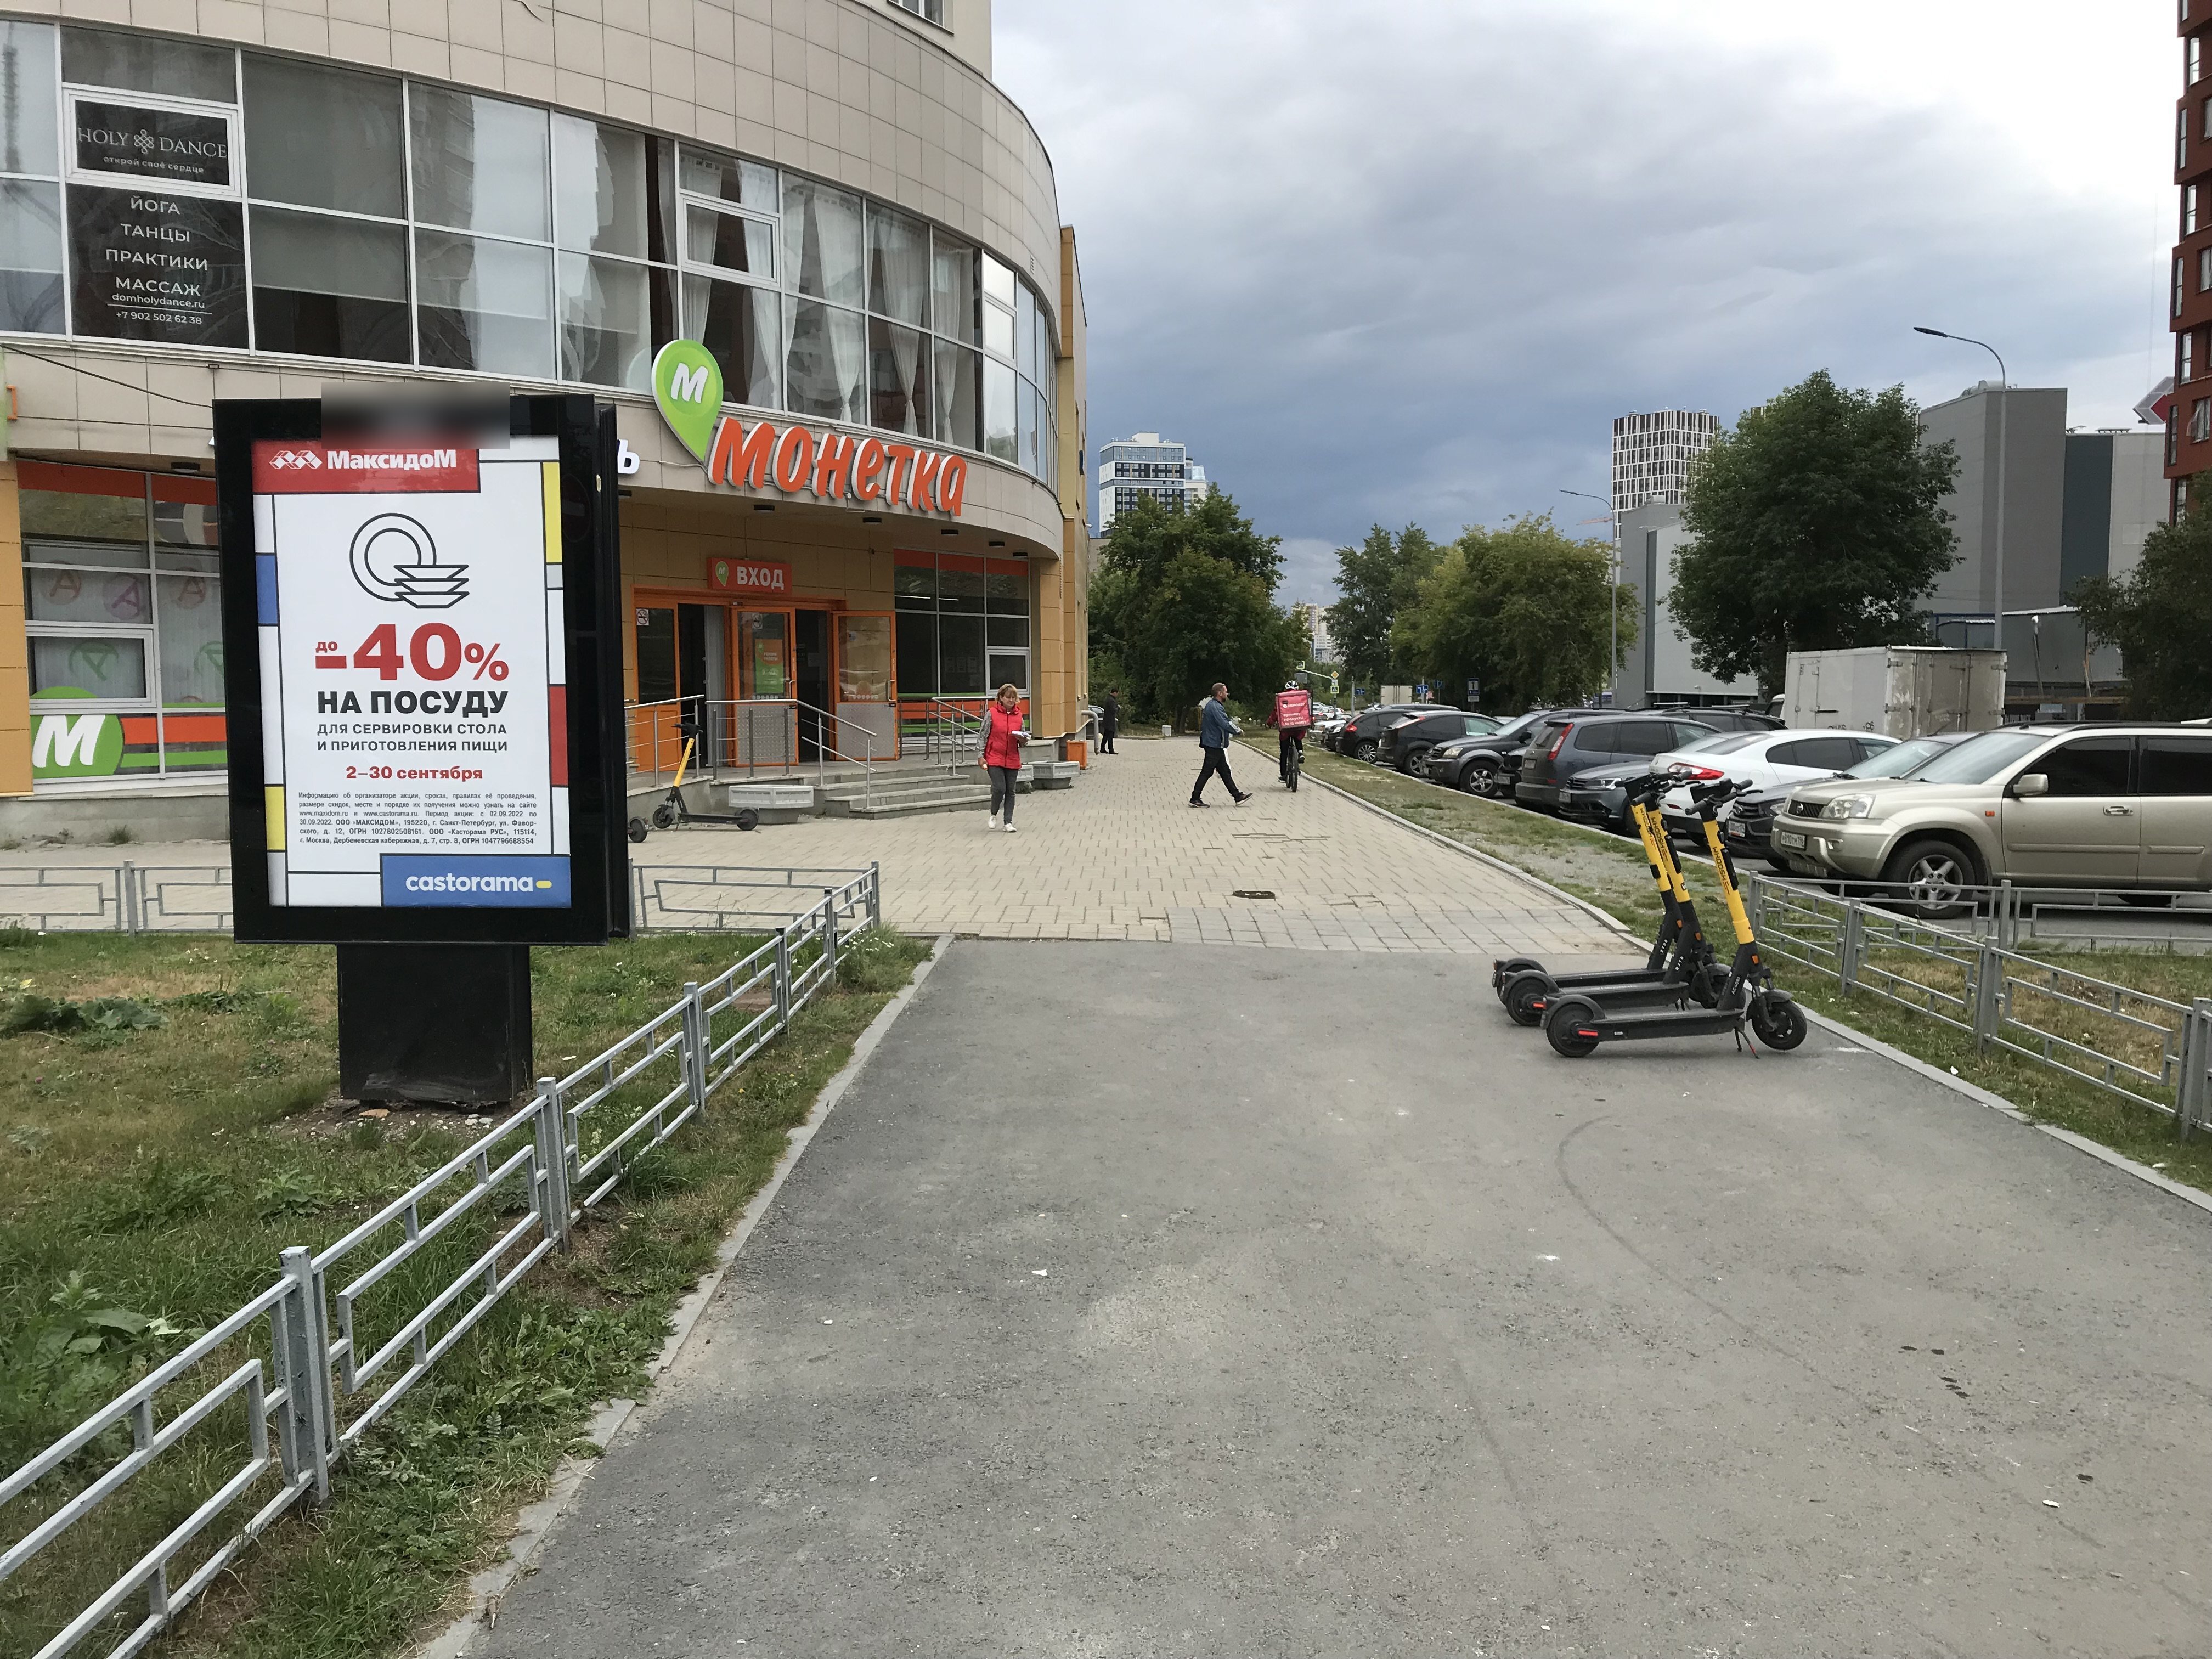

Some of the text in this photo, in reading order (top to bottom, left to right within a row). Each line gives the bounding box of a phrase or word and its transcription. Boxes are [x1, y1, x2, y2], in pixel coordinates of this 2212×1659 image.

[77, 127, 227, 158] HOLY DANCE
[103, 156, 139, 165] открой
[168, 164, 204, 173] сердце
[130, 195, 180, 215] ЙОГА
[120, 223, 190, 242] ТАНЦЫ
[105, 249, 207, 271] ПРАКТИКИ
[115, 276, 201, 296] МАССАЖ
[112, 293, 205, 308] domholydance.ru
[131, 312, 151, 321] 902
[153, 313, 172, 323] 502
[174, 315, 187, 324] 62
[189, 316, 202, 325] 38
[737, 566, 785, 590] ВХОД
[315, 641, 338, 653] до
[318, 690, 509, 718] НА ПОСУДУ
[317, 724, 507, 736] ДЛЯ СЕРВИРОВКИ СТОЛА
[317, 741, 507, 753] И ПРИГОТОВЛЕНИЯ ПИЩИ
[397, 765, 483, 782] сентября
[1651, 817, 1666, 850] WHOOSH
[1712, 846, 1727, 881] WHOOSH
[405, 873, 533, 892] castorama
